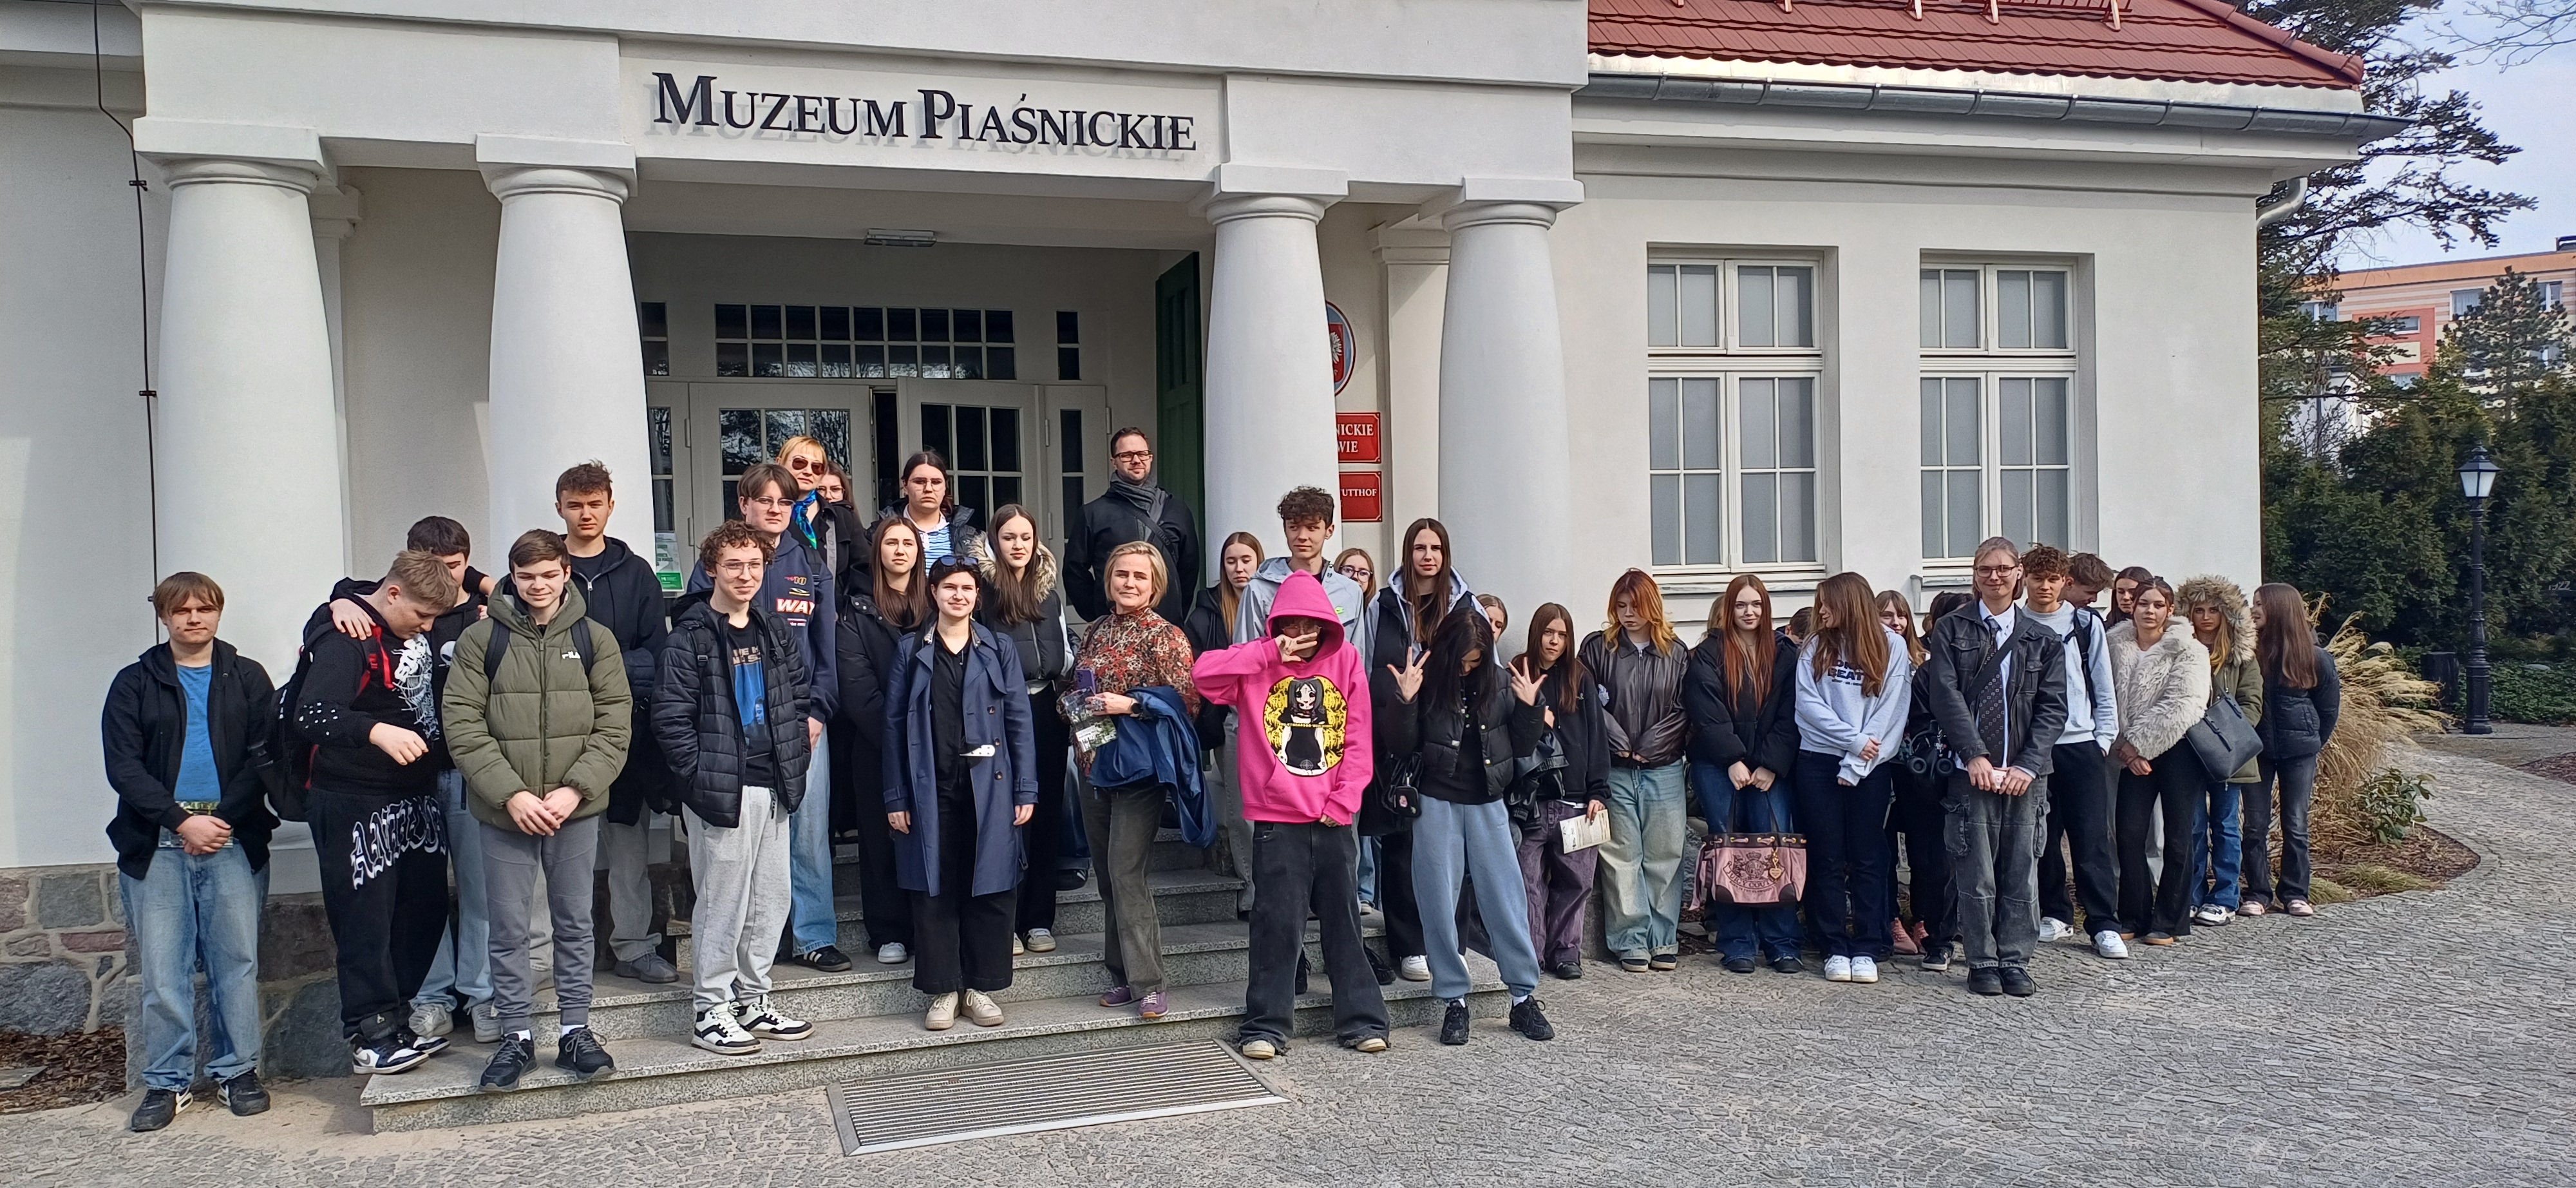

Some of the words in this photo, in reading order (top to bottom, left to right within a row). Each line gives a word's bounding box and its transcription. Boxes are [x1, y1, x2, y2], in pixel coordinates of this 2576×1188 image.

[652, 72, 909, 138] MUZEUM
[1341, 488, 1378, 497] UTTHOF
[1727, 870, 1747, 886] JUICY
[1748, 877, 1775, 888] COUTU
